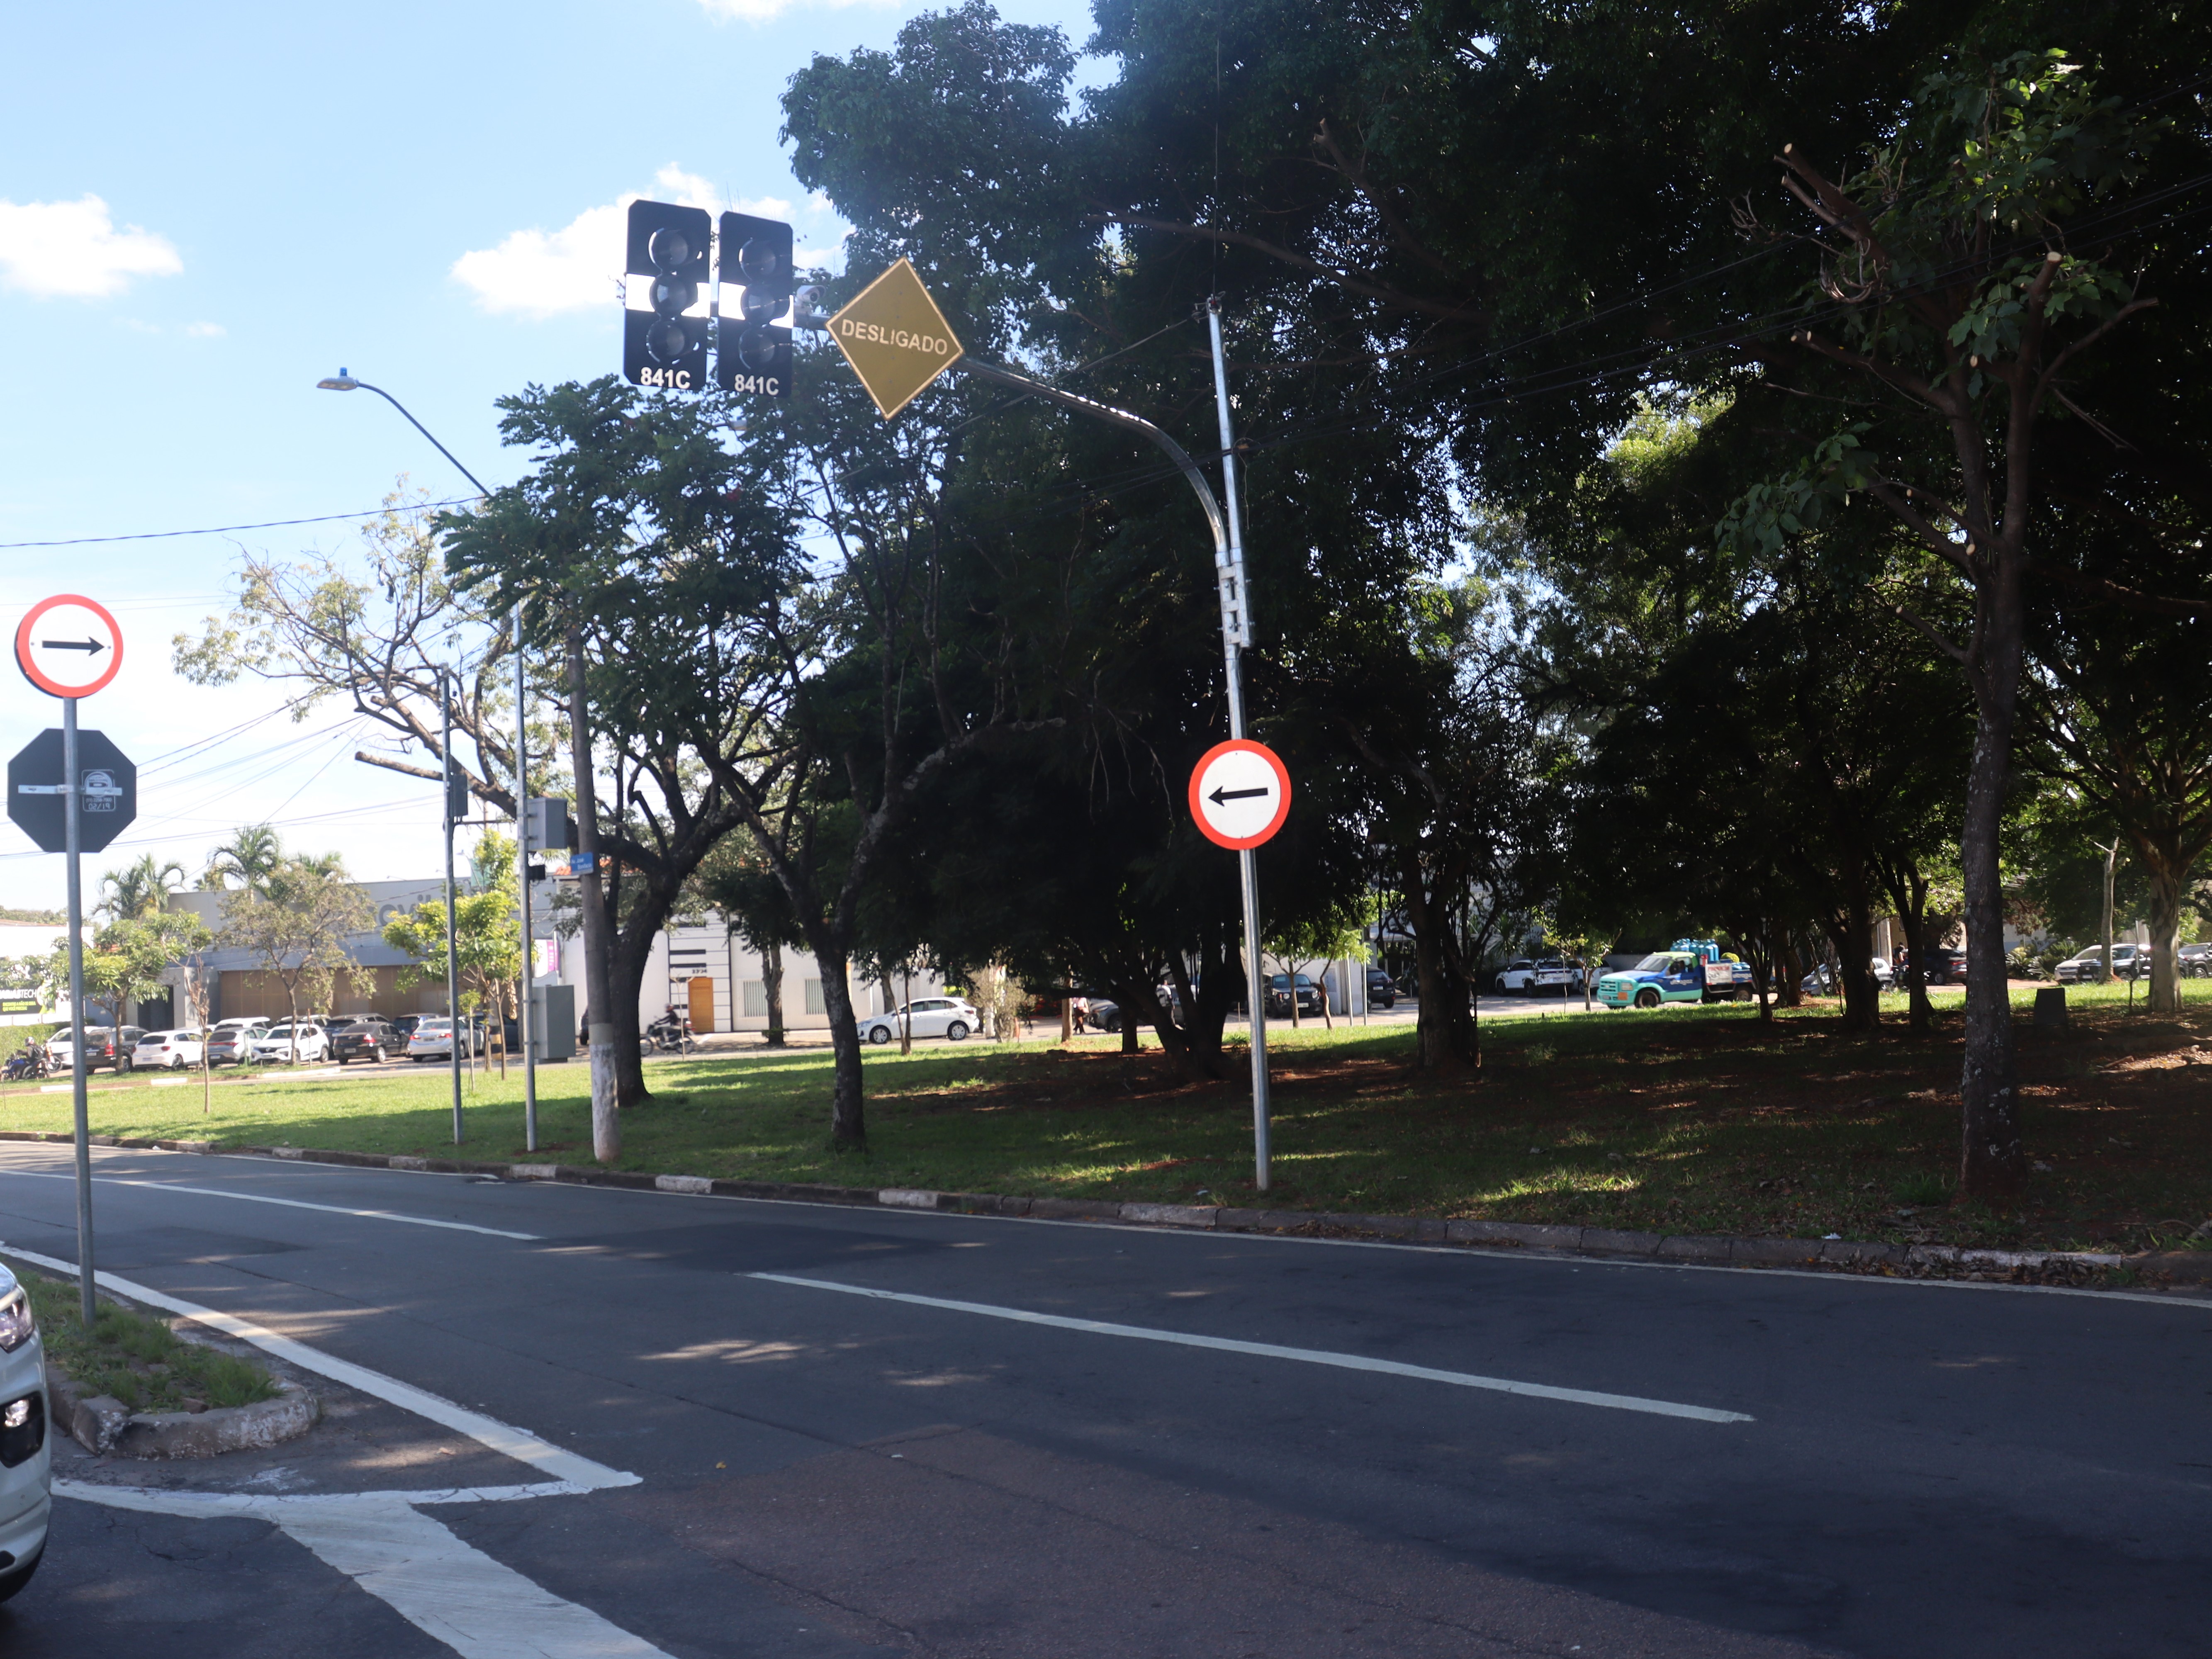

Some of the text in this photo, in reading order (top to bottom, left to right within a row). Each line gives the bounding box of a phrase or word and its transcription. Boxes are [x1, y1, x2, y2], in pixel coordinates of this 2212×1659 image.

[841, 319, 948, 355] DESLIGADO
[640, 367, 691, 389] 841C
[734, 374, 779, 395] 841C
